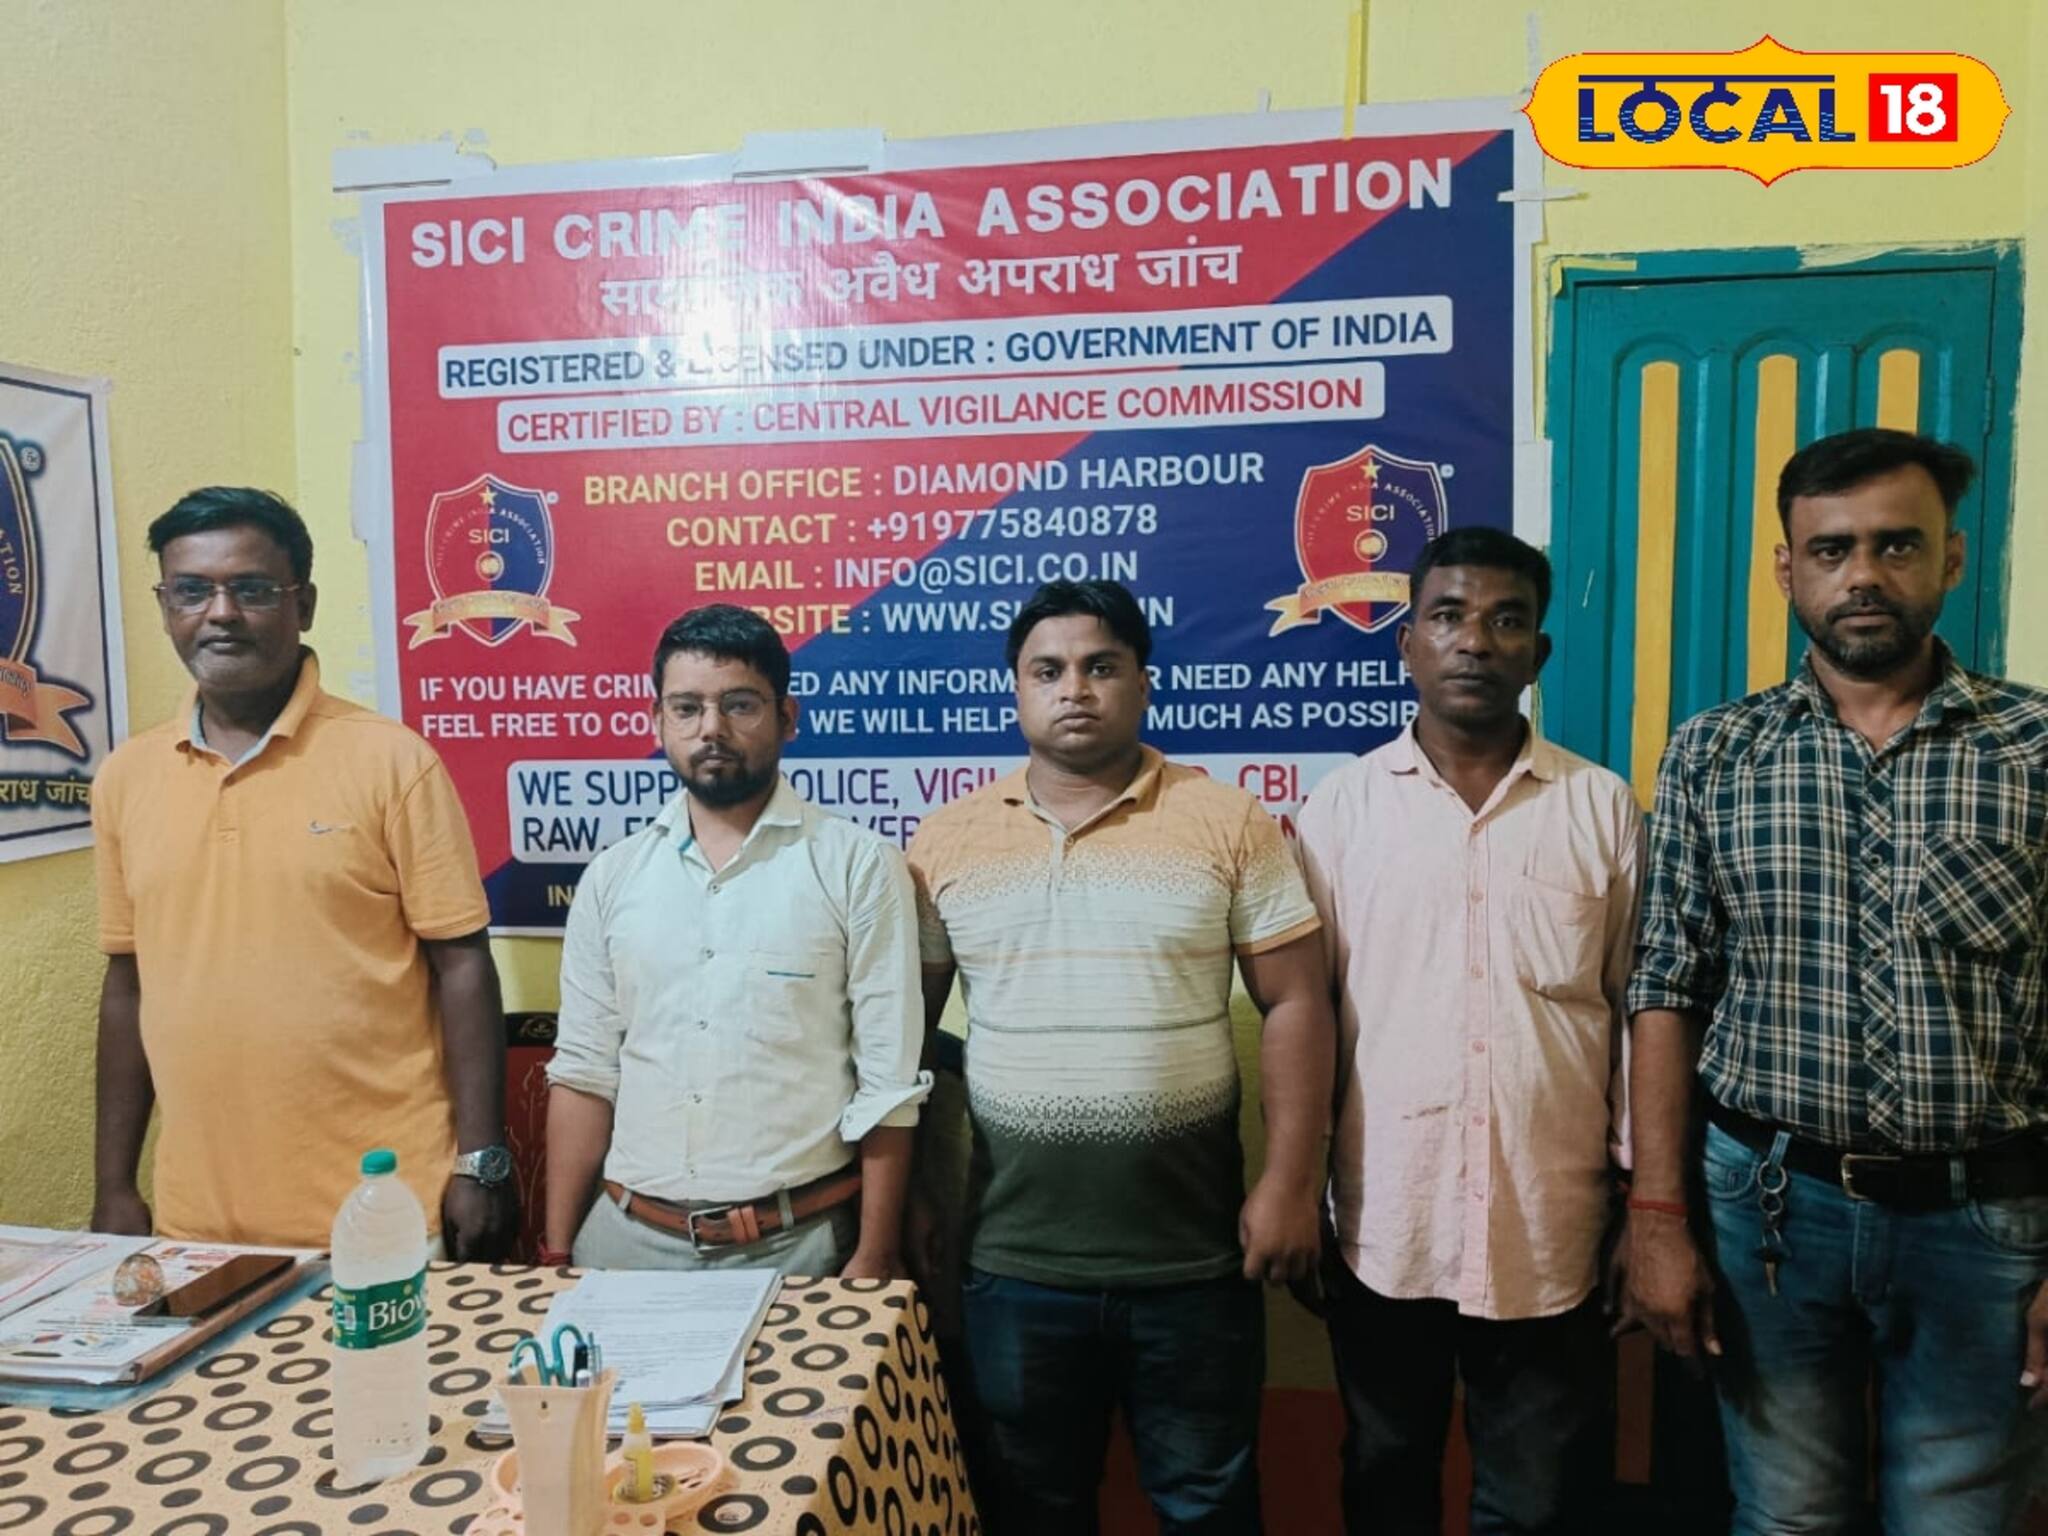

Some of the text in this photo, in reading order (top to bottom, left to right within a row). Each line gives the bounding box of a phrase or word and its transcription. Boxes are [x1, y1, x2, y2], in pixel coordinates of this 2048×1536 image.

[411, 158, 1452, 268] SICI CRIME INDIA ASSOCIATION
[819, 251, 940, 304] अवैध
[958, 252, 1119, 297] अपराध
[1137, 236, 1242, 288] जांच
[445, 349, 643, 389] REGISTERED
[655, 349, 677, 378] &
[859, 334, 975, 370] UNDER
[1006, 320, 1260, 363] GOVERNMENT
[1271, 316, 1320, 350] OF
[1332, 311, 1437, 347] INDIA
[507, 406, 672, 442] CERTIFIED
[683, 404, 725, 435] BY
[754, 397, 911, 432] CENTRAL
[919, 391, 1107, 427] VIGILANCE
[1117, 377, 1364, 420] COMMISSION
[584, 469, 729, 505] BRANCH
[739, 466, 862, 501] OFFICE
[893, 459, 1070, 497] DIAMOND
[1080, 453, 1265, 490] HARBOUR
[666, 513, 838, 548] CONTACT
[867, 504, 1158, 542] +919775840878
[1346, 504, 1395, 522] SICI
[468, 528, 510, 544] SICI
[695, 558, 805, 592] EMAIL
[835, 551, 1138, 594] INFO@SICI.CO.IN
[750, 604, 852, 635] SITE
[420, 677, 444, 701] IF
[450, 676, 505, 701] YOU
[513, 675, 587, 700] HAVE
[828, 670, 890, 696] ANY
[1171, 663, 1252, 690] NEED
[1260, 661, 1328, 689] ANY
[421, 713, 484, 738] FEEL
[490, 712, 557, 737] FREE
[563, 712, 602, 737] TO
[808, 709, 856, 734] WE
[861, 708, 935, 734] WILL
[942, 706, 1018, 733] HELP
[1146, 703, 1242, 731] MUCH
[1250, 702, 1294, 730] AS
[1301, 699, 1420, 728] POSSIB
[518, 769, 573, 806] WE
[786, 768, 900, 810] OLICE,
